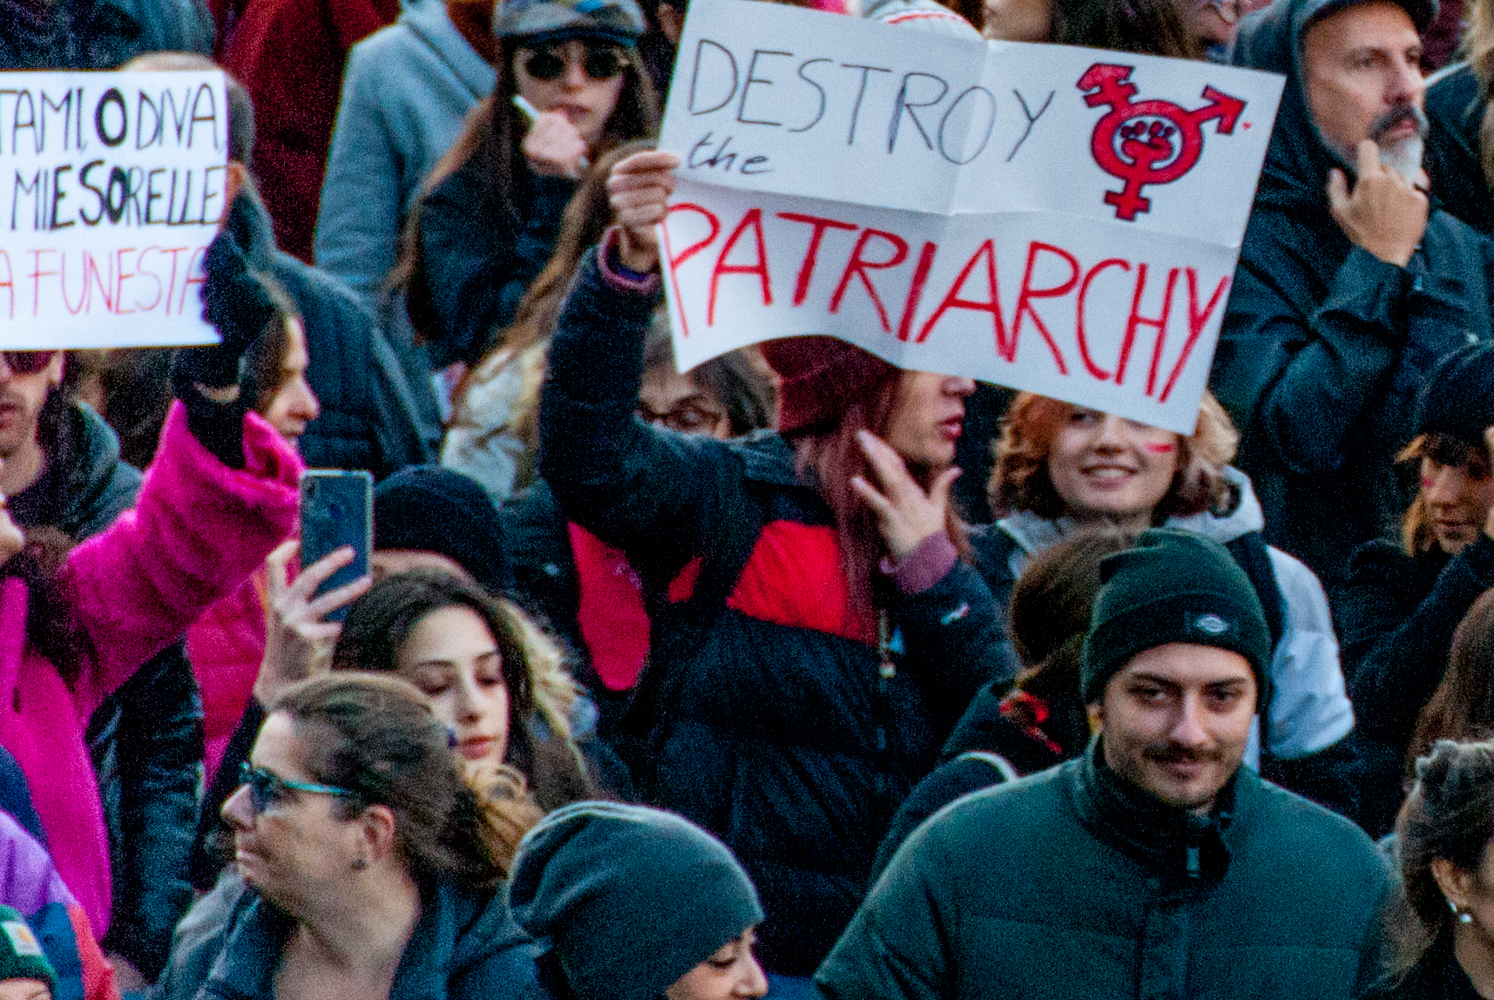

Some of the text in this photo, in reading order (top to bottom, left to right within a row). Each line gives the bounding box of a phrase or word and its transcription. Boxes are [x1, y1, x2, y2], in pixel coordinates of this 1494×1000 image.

[95, 86, 127, 148] O
[690, 38, 1057, 165] DESTROY
[686, 130, 776, 175] the
[10, 159, 227, 232] MIE SORELLE
[28, 245, 208, 317] FUNESTA
[660, 201, 1233, 405] PATRIARCHY
